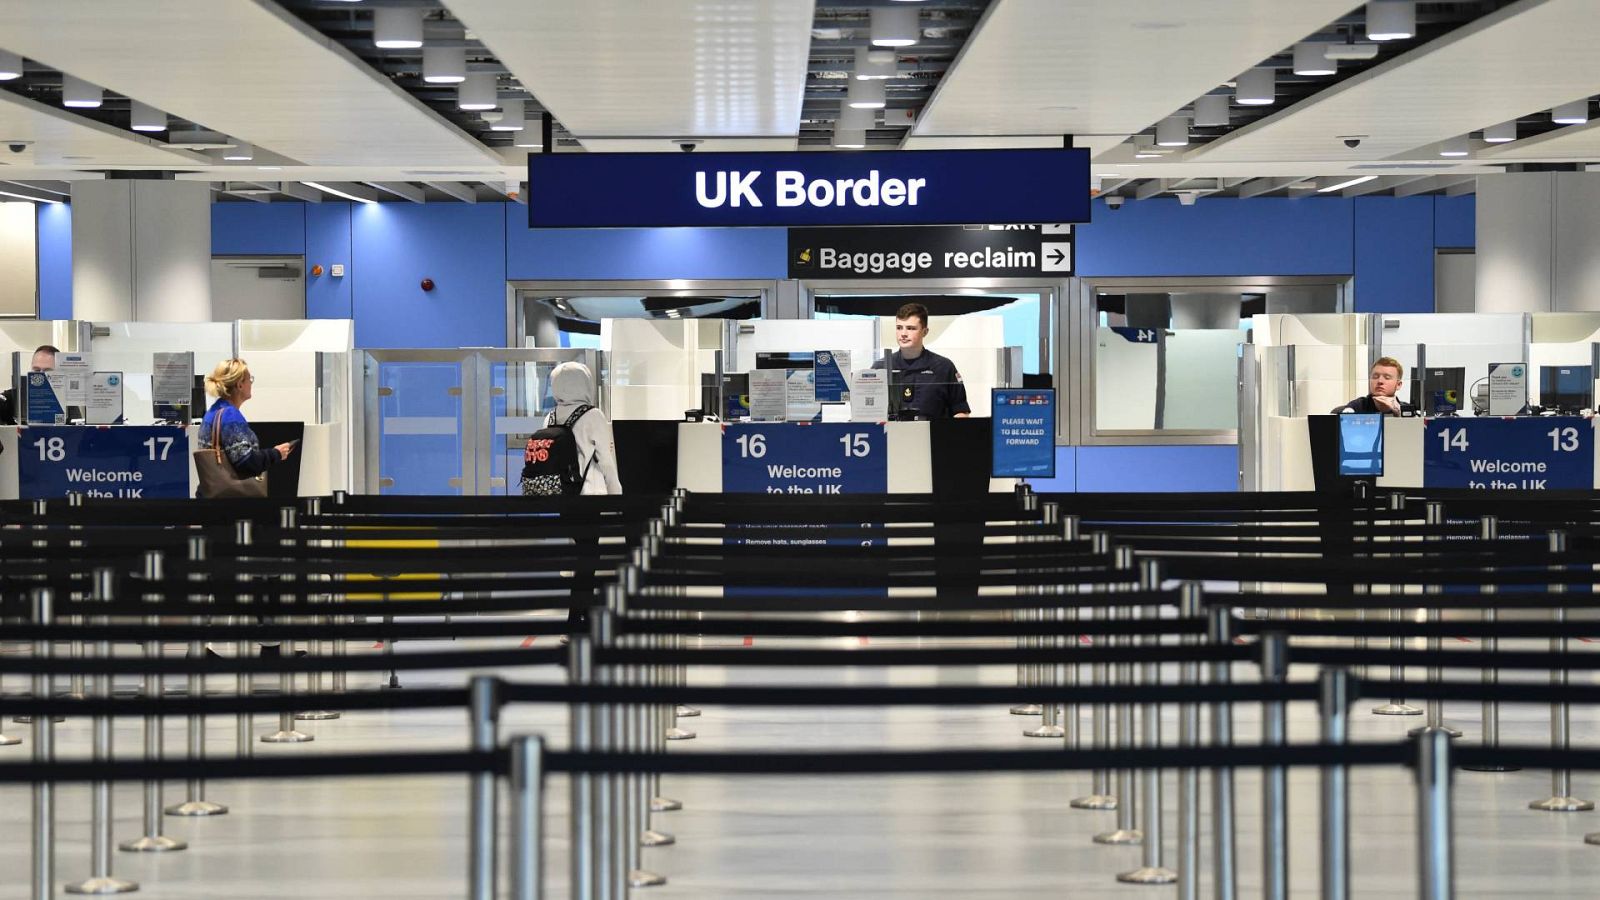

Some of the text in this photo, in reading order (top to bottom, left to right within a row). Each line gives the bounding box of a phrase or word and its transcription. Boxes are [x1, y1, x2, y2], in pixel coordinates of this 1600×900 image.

[695, 168, 927, 208] UK Border
[820, 246, 1036, 273] Baggage reclaim
[34, 437, 66, 462] 18
[143, 437, 174, 461] 17
[736, 433, 767, 458] 16
[839, 433, 871, 458] 15
[1438, 428, 1469, 451] 14
[1547, 428, 1579, 452] 13
[66, 468, 143, 482] Welcome
[767, 464, 842, 478] Welcome
[1470, 459, 1547, 473] Welcome
[87, 489, 114, 498] the
[119, 489, 143, 498] UK
[766, 485, 843, 494] to the UK
[1469, 480, 1547, 490] to the UK
[790, 538, 827, 547] sunglasses
